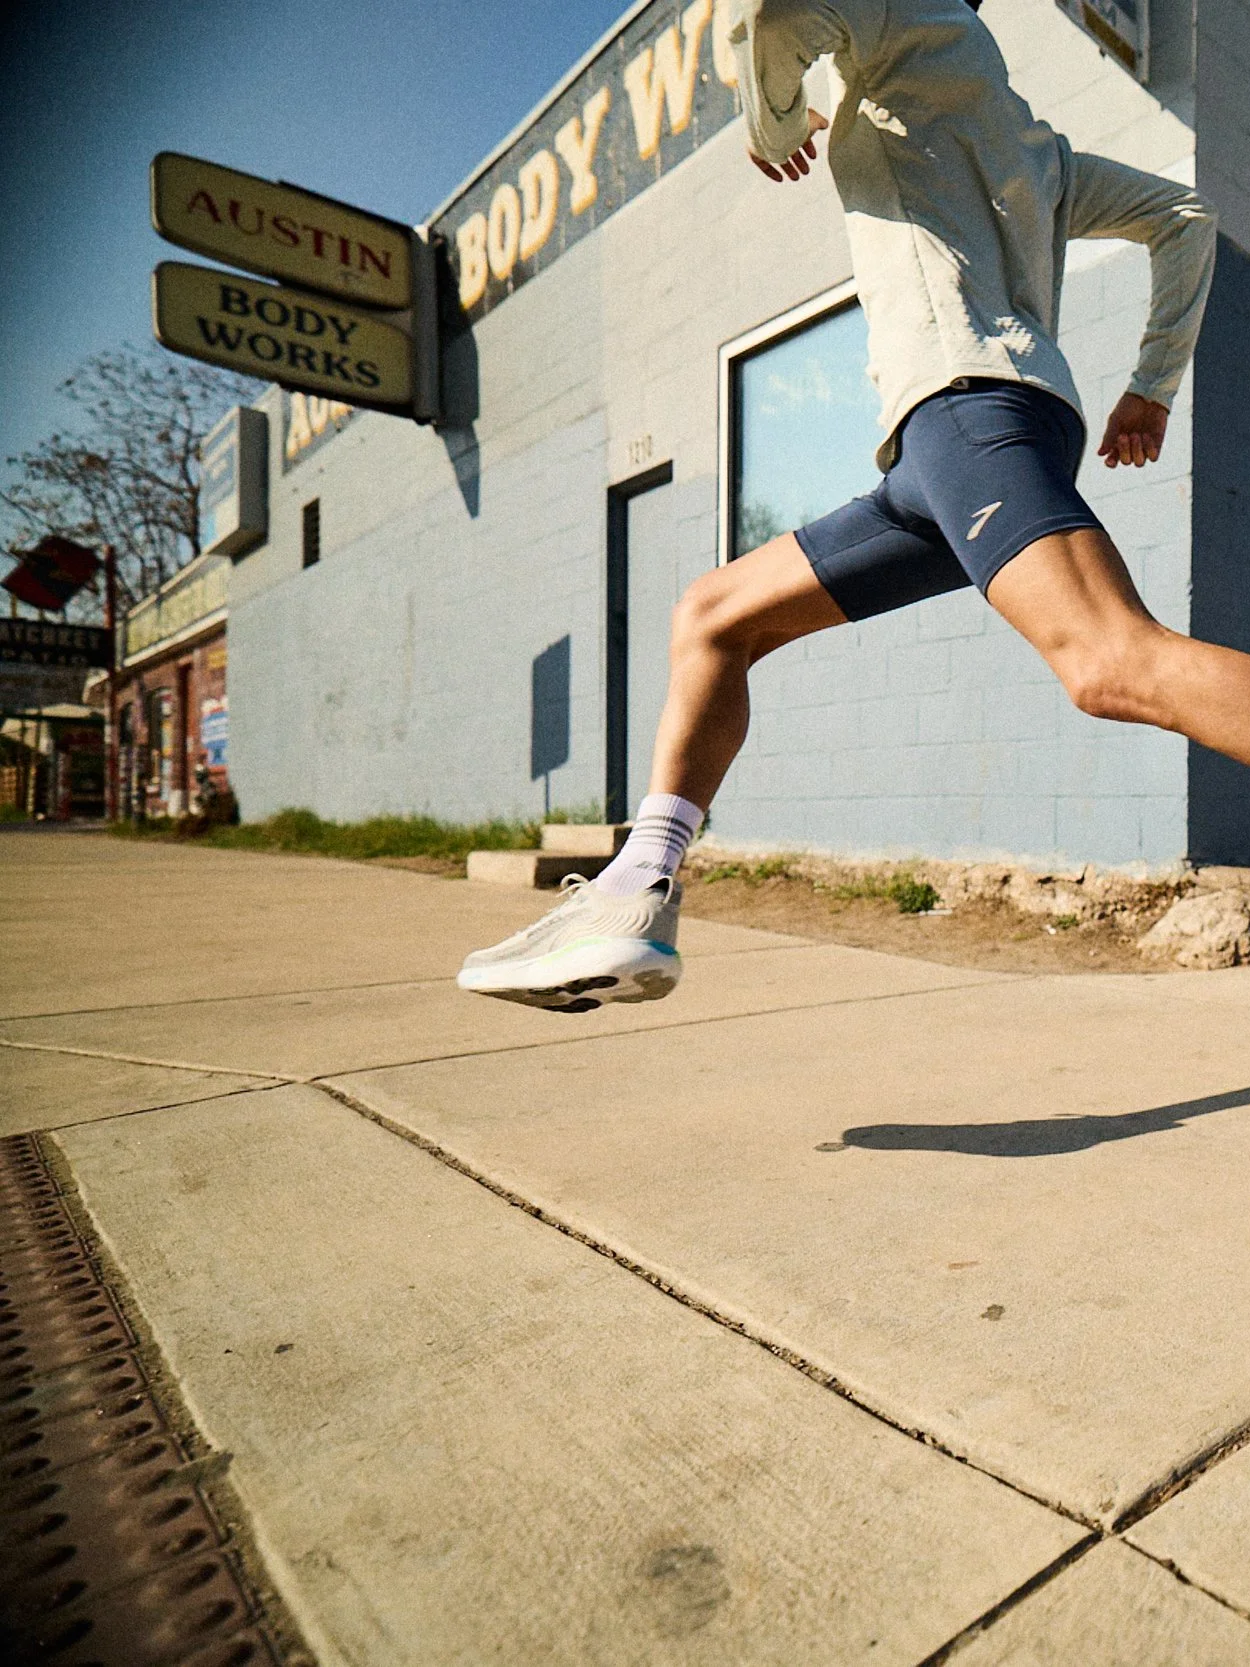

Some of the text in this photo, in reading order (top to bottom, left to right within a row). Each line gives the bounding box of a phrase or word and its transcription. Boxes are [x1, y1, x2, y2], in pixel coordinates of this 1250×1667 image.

[186, 189, 392, 281] AUSTIN
[455, 86, 612, 312] BODY
[196, 316, 381, 388] WORKS
[219, 284, 359, 346] BODY
